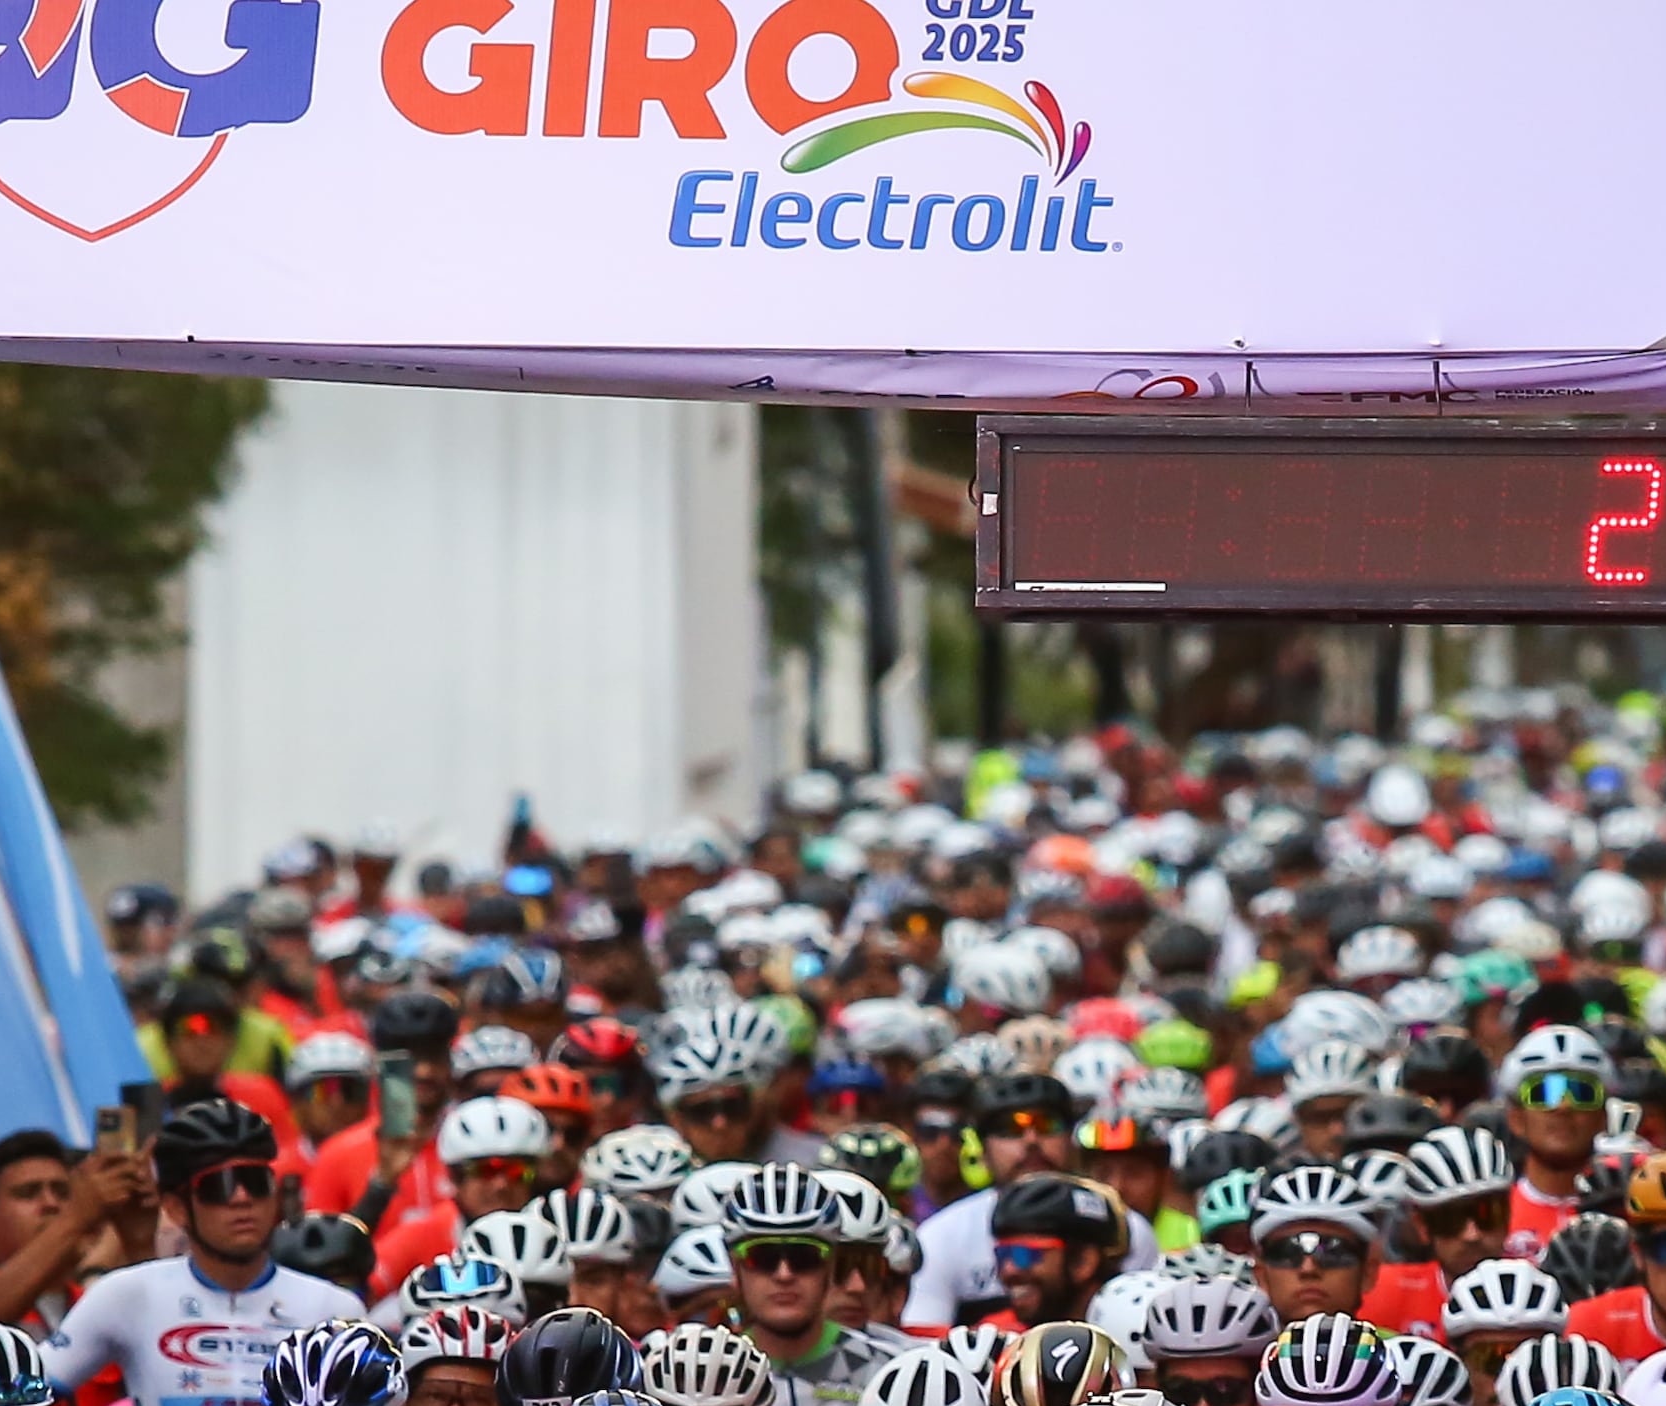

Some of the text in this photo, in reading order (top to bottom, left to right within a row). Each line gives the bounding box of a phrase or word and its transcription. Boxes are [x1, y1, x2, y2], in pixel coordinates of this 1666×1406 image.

[381, 0, 900, 139] GIRO
[923, 23, 1026, 63] 2025
[668, 168, 1114, 252] Electrolit
[1587, 460, 1661, 583] 2
